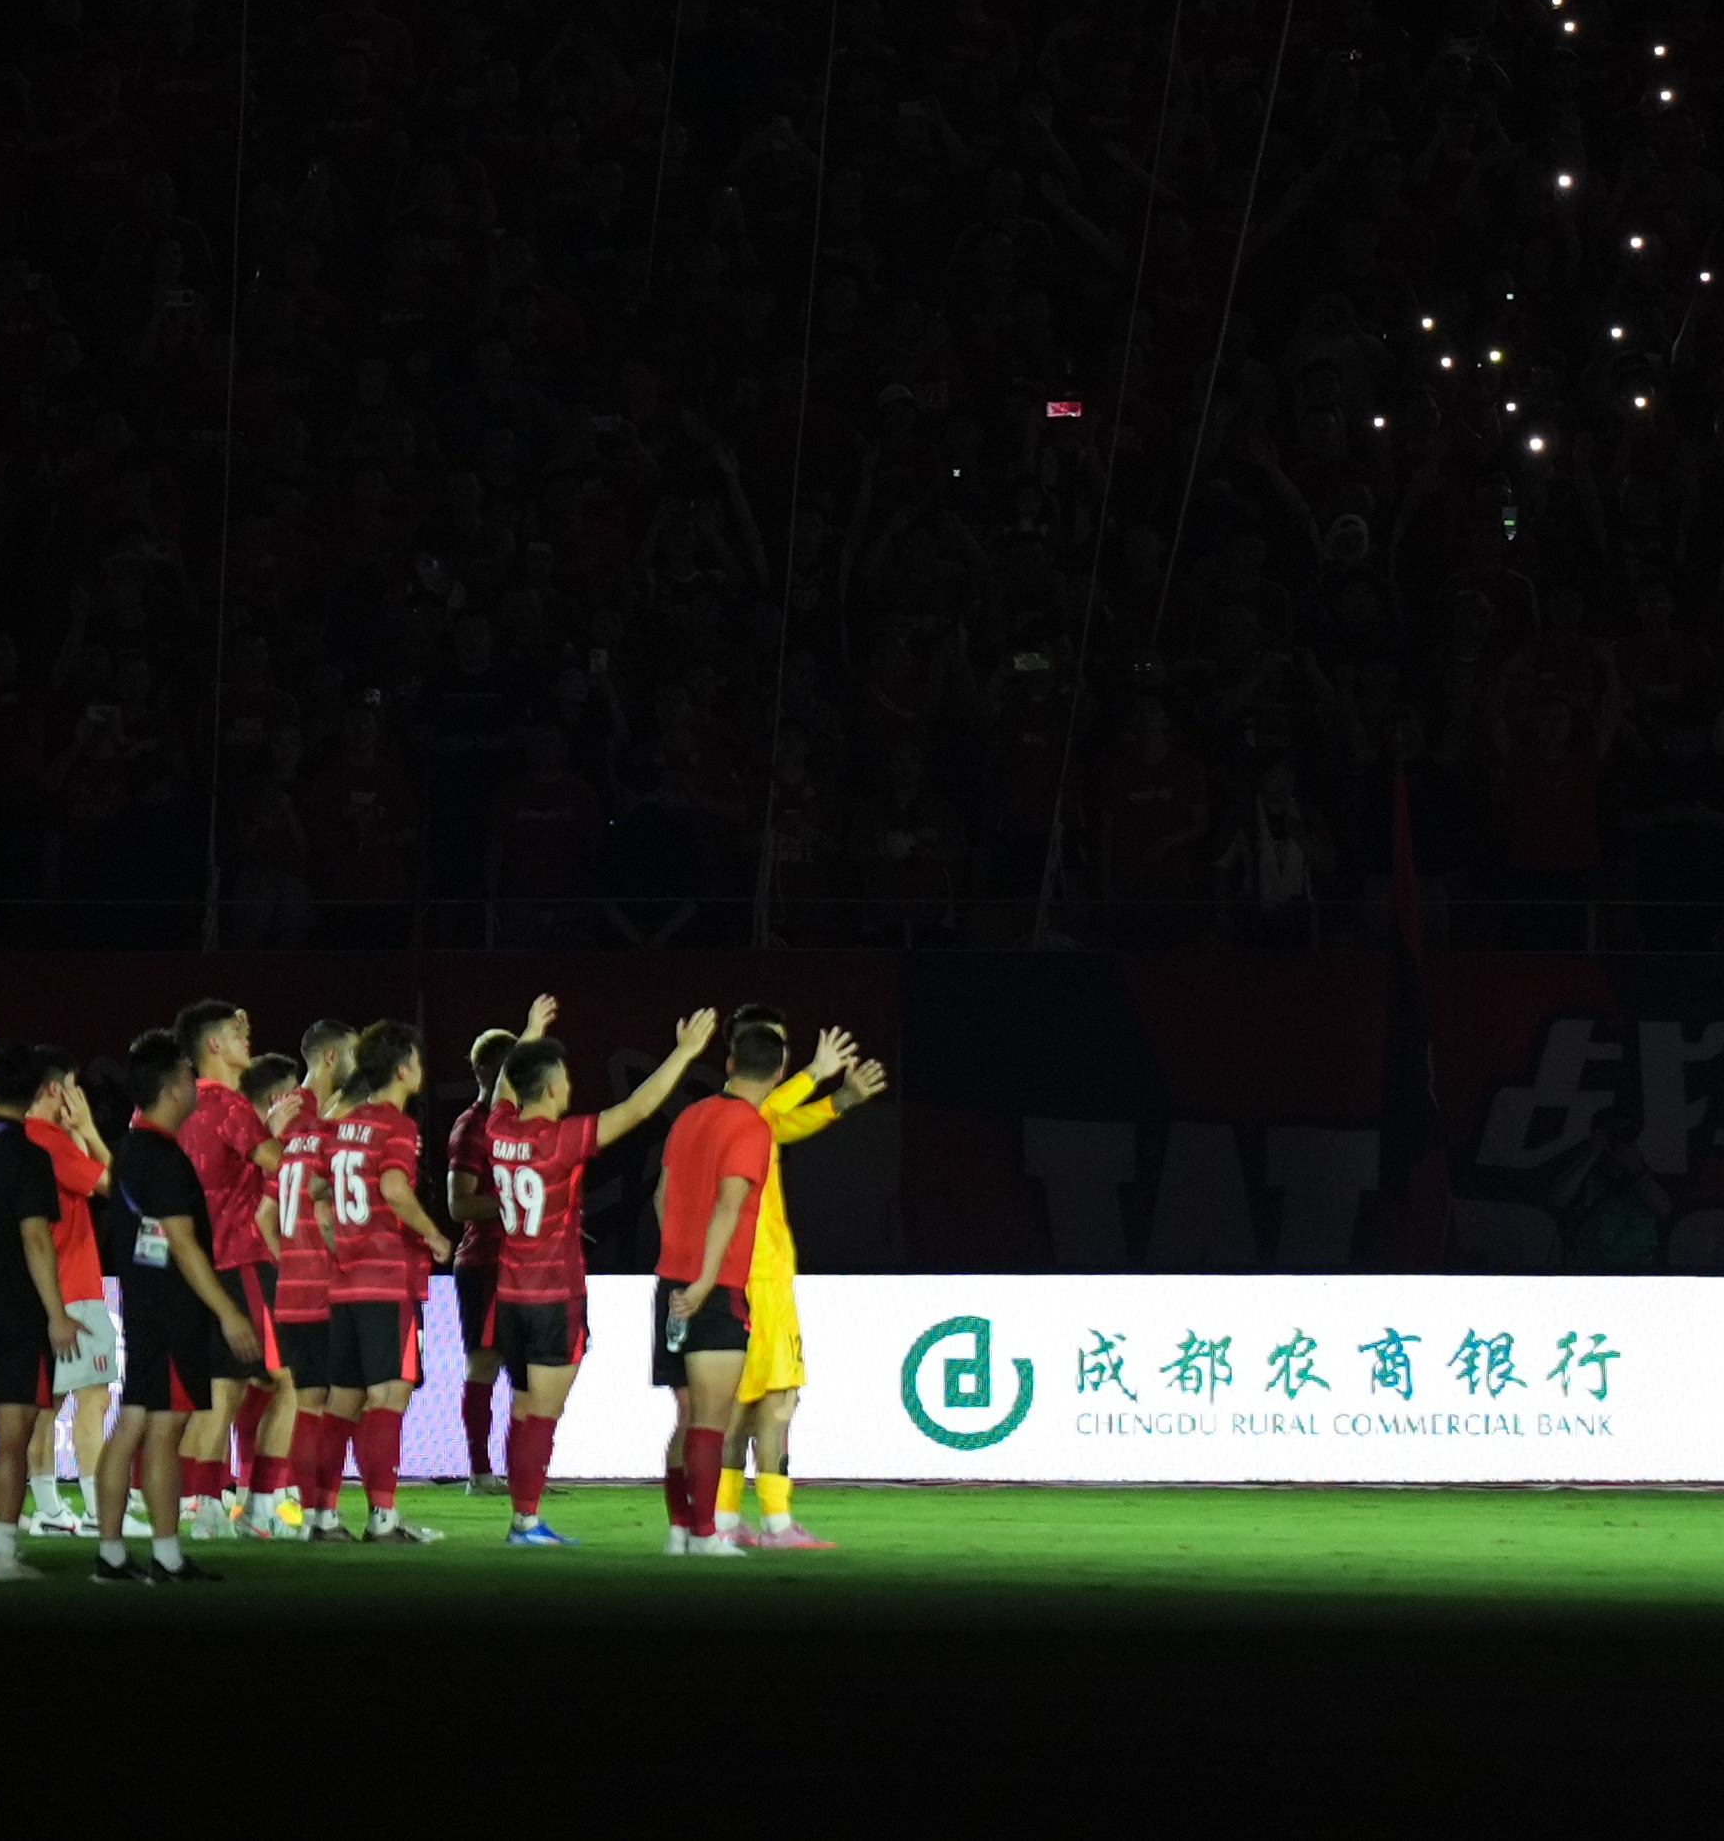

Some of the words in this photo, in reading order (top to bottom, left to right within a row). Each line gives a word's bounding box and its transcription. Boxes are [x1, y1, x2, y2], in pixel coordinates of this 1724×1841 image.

[331, 1150, 371, 1226] 15
[492, 1164, 546, 1237] 39
[1075, 1326, 1622, 1406] 成都农商银行
[1075, 1412, 1219, 1436] CHENGDU
[1231, 1413, 1321, 1436] RURAL
[1333, 1413, 1525, 1436] COMMERCIAL
[1537, 1414, 1617, 1437] BANK
